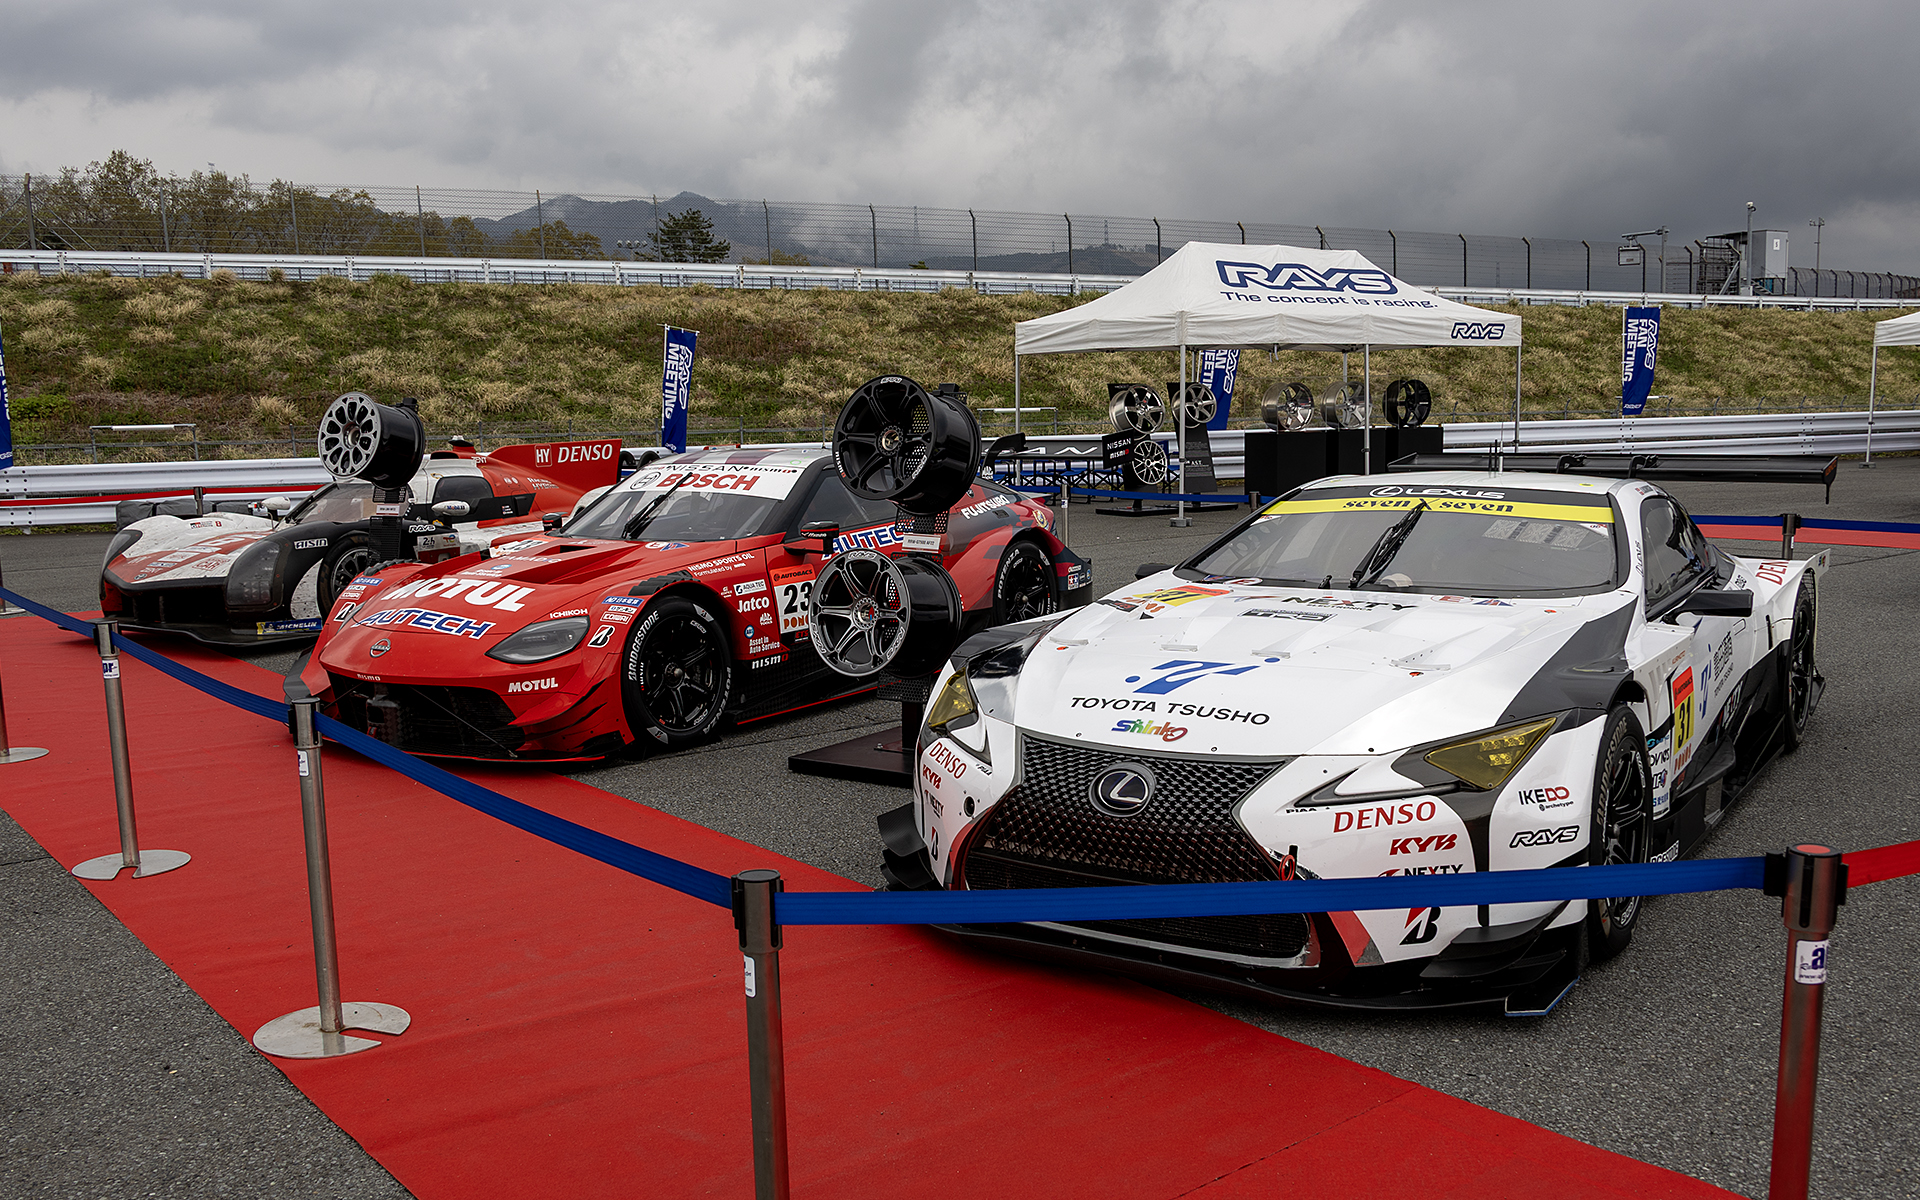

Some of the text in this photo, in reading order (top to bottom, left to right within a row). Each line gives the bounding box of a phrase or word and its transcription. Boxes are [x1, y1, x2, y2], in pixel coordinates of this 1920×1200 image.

[1216, 259, 1398, 295] RAYS
[1220, 292, 1438, 309] The concept is racing.
[1451, 322, 1505, 340] RAYS
[1637, 319, 1648, 347] FAN
[1623, 319, 1639, 382] MEETING
[1644, 319, 1658, 370] RAYS
[1215, 350, 1228, 369] AN
[665, 343, 680, 420] MEETING
[536, 444, 613, 464] HY DENSO
[1107, 438, 1132, 450] NISSAN
[672, 464, 744, 472] NISSAN
[656, 473, 760, 491] BOSCH
[1405, 487, 1506, 499] LEXUS
[961, 494, 1010, 520] FUJITSUBO
[1342, 499, 1410, 510] seven
[1440, 502, 1515, 514] seven
[409, 525, 436, 533] RAYS
[688, 561, 713, 572] NISMO
[713, 555, 742, 567] SPORTS
[741, 552, 755, 560] OIL
[848, 551, 877, 560] RAYS
[694, 565, 726, 577] Formulated
[780, 569, 813, 579] AUTOBACS
[998, 549, 1020, 599] POTENZA
[380, 578, 536, 612] MOTUL
[737, 596, 770, 613] Jatco
[783, 582, 812, 615] 23
[1281, 596, 1419, 611] NEXTY
[550, 608, 588, 619] ICHIKOH
[276, 622, 317, 630] MICHELIN
[351, 608, 496, 640] AUTECH
[628, 611, 660, 681] BRIDGESTONE
[752, 653, 789, 670] nismo
[508, 678, 558, 692] MOTUL
[1070, 696, 1270, 725] TOYOTA TSUSHO
[1678, 695, 1692, 750] 31
[929, 742, 967, 779] DENSO
[1596, 717, 1628, 826] BRIDGESTONE
[1518, 786, 1570, 806] IKEDO
[1544, 800, 1575, 811] archetype
[1333, 801, 1436, 833] DENSO
[1389, 833, 1458, 855] KYB
[1509, 825, 1580, 848] RAYS
